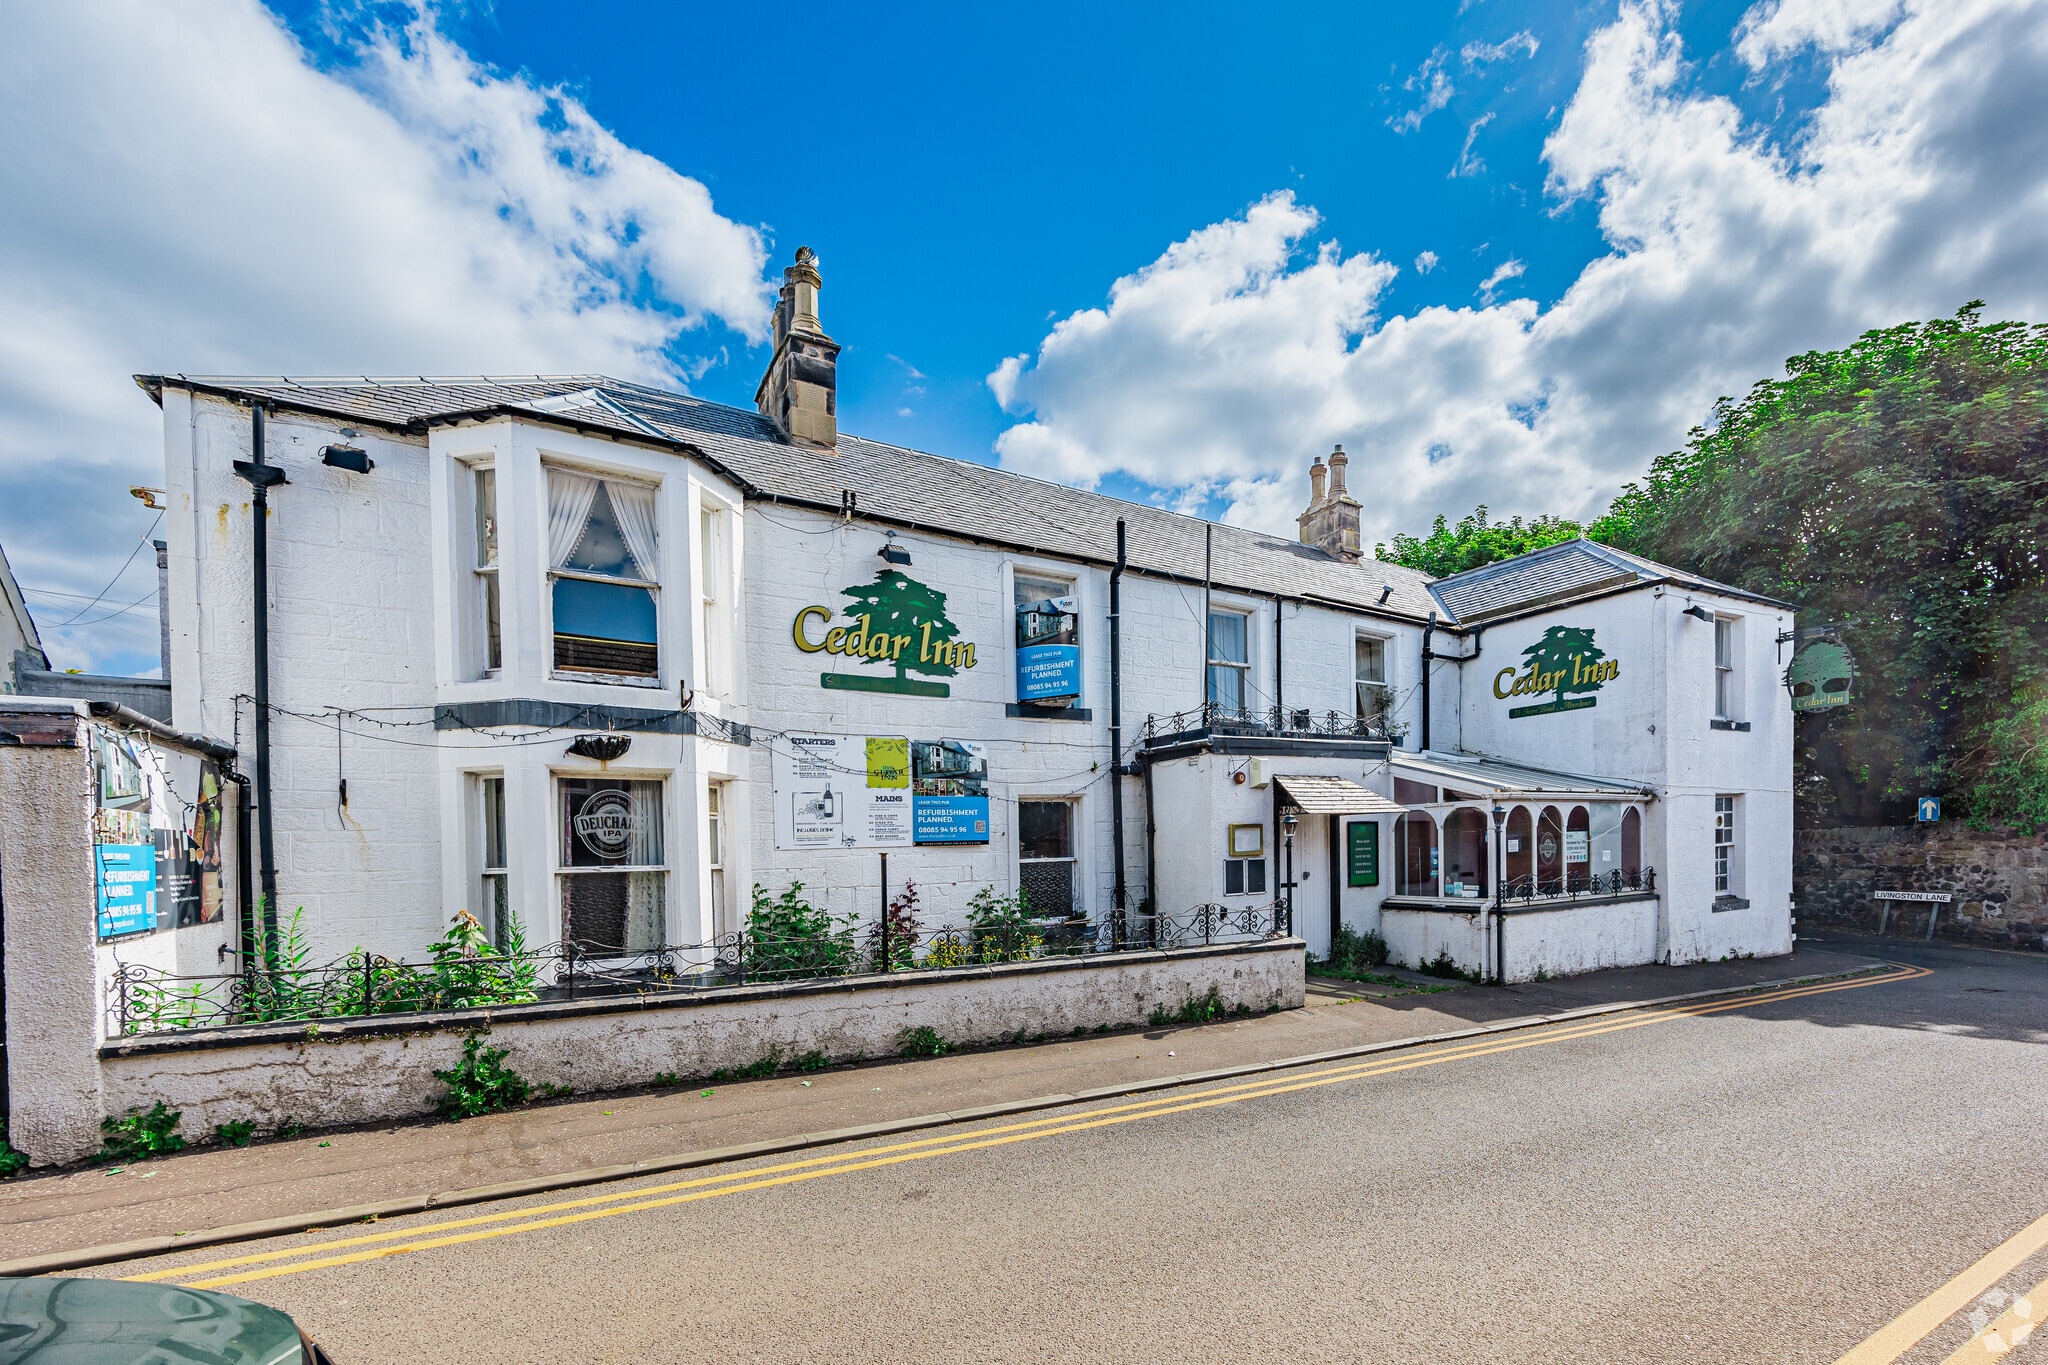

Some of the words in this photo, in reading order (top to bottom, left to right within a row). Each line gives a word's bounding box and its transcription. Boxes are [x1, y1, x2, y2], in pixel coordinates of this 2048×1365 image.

[793, 605, 911, 660] Cedar
[919, 621, 978, 669] Inn
[1021, 660, 1074, 673] REFURBISHMENT
[1032, 670, 1063, 679] PLANNED.
[1493, 662, 1567, 699] Cedar
[1572, 653, 1620, 686] Inn
[1796, 697, 1824, 708] Cedar
[1827, 694, 1843, 704] Inn
[792, 737, 836, 745] STARTERS
[1876, 892, 1922, 900] LIVINGSTON
